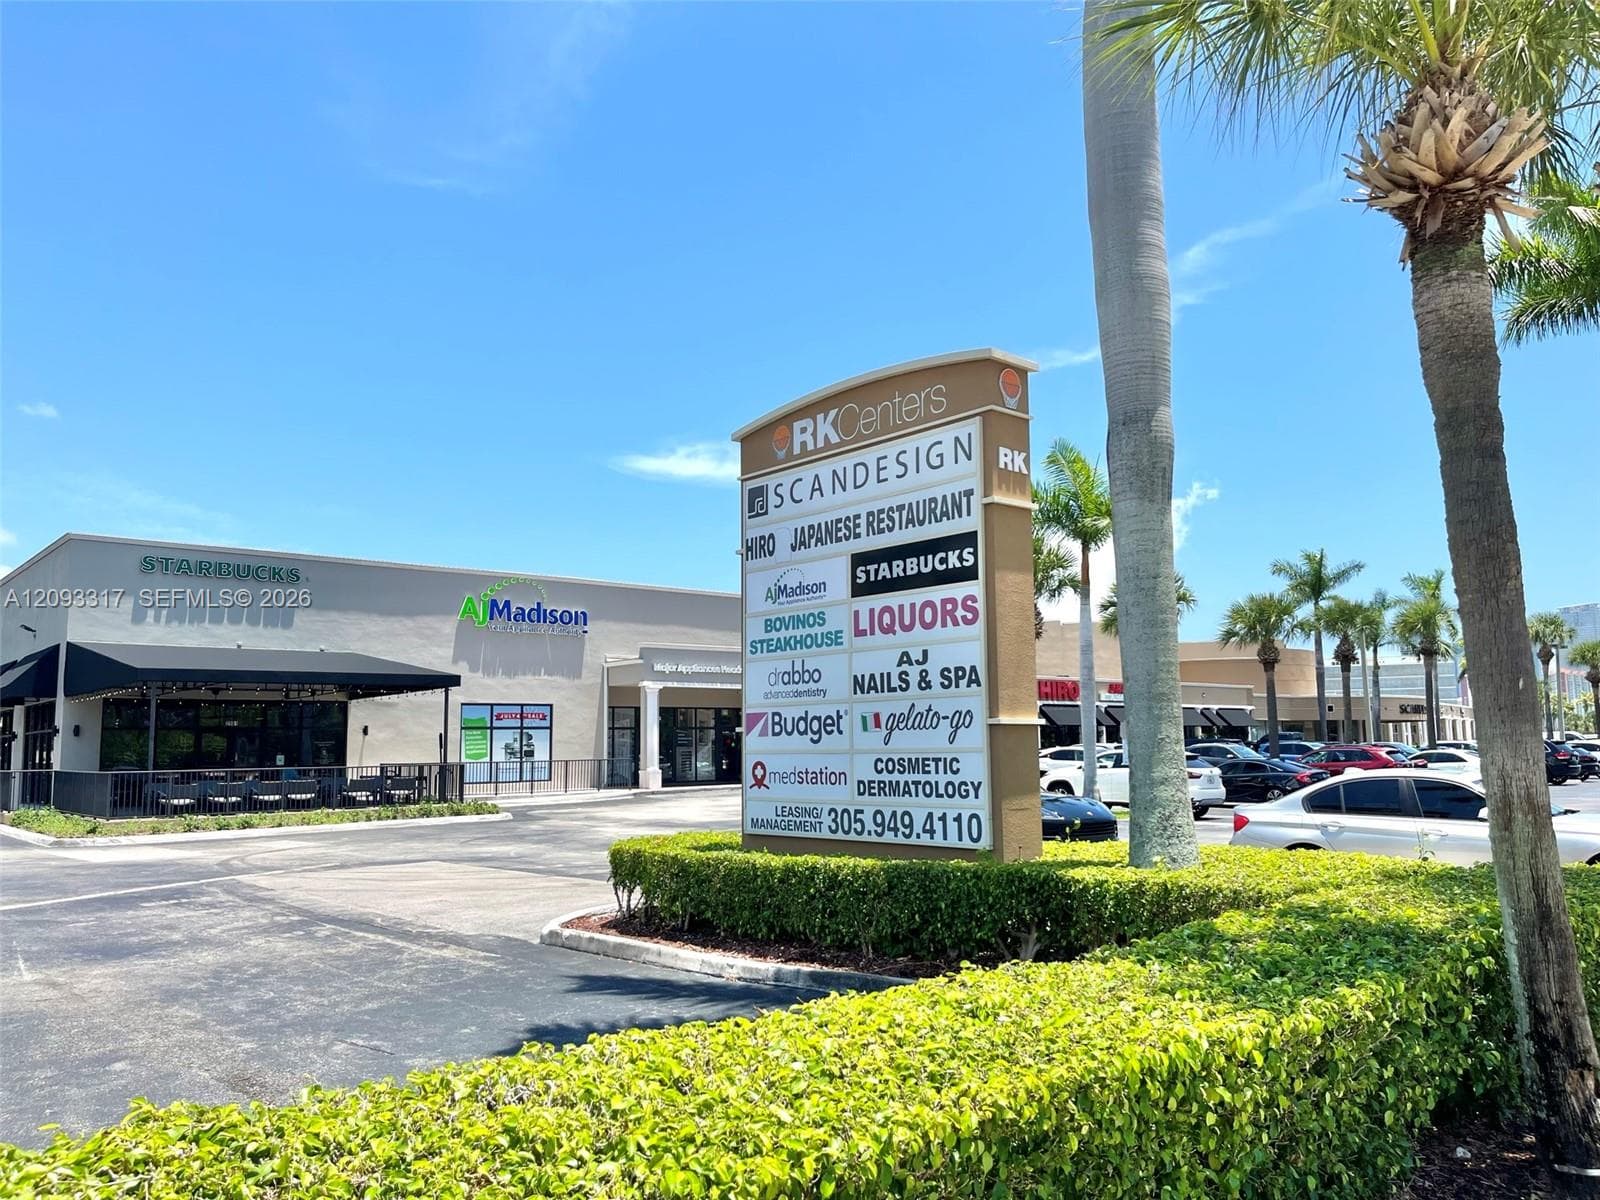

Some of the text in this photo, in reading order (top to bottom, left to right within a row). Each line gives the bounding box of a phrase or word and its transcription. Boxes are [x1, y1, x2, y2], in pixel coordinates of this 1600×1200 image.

[773, 432, 973, 510] SCANDESIGN
[999, 446, 1029, 474] RK
[745, 488, 974, 562] HIRO JAPANESE RESTAURANT
[140, 555, 302, 584] STARBUCKS
[856, 548, 975, 584] STARBUCKS
[764, 611, 826, 634] BOVINOS
[853, 594, 980, 638] LIQUORS
[749, 630, 844, 655] STEAKHOUSE
[896, 649, 928, 668] AJ
[768, 659, 822, 686] drabbo
[852, 665, 982, 695] NAILS & SPA
[1038, 680, 1080, 701] HIRO
[884, 702, 974, 746] gelato-go
[768, 766, 848, 786] medstation
[874, 757, 960, 775] COSMETIC
[857, 780, 983, 800] DERMATOLOGY
[750, 818, 824, 832] MANAGEMENT
[775, 806, 824, 820] LEASING/
[828, 807, 983, 844] 305.949.4110
